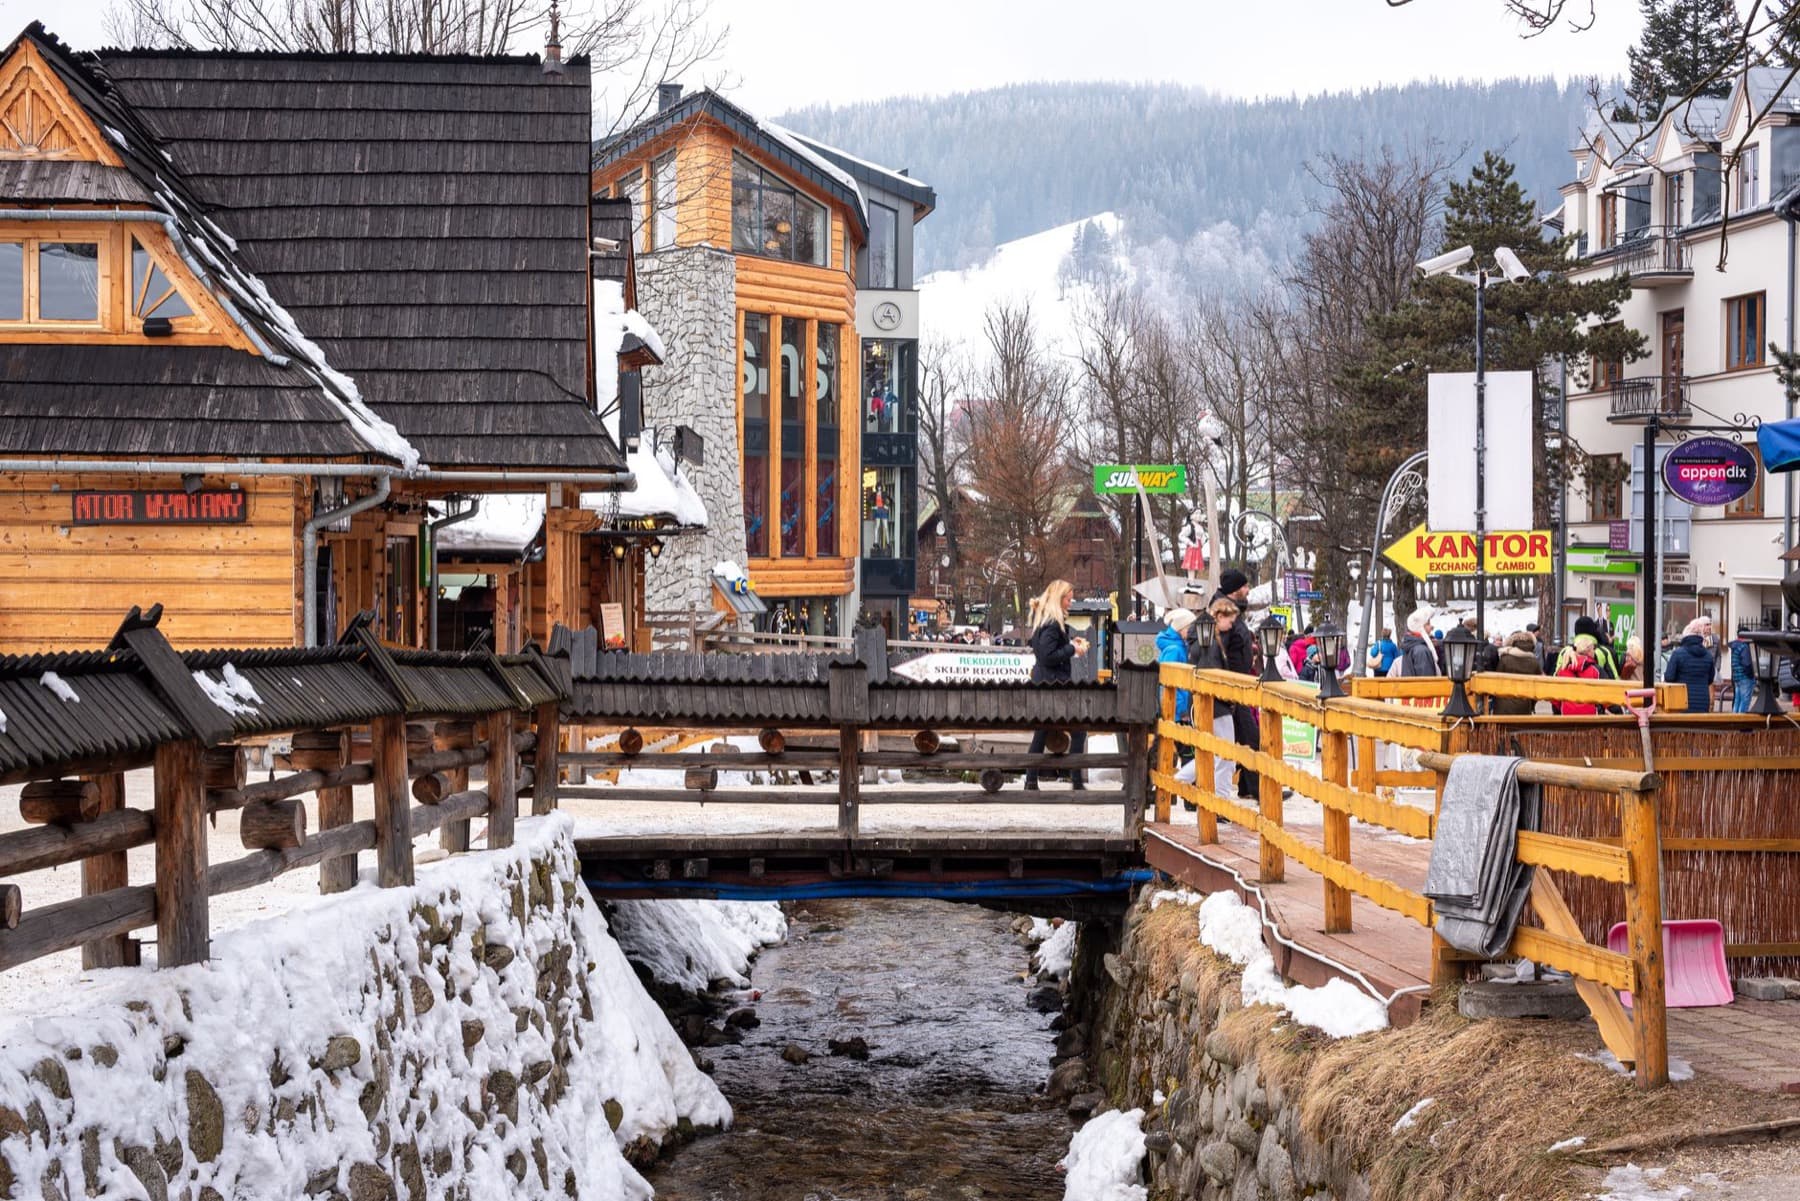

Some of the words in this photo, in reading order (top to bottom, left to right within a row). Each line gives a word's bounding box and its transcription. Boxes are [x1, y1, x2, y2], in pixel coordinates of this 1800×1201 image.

[1104, 471, 1177, 488] SUBWAY
[1681, 465, 1747, 480] appendix
[1416, 534, 1549, 559] KANTOR
[1429, 562, 1477, 572] EXCHANG
[1496, 561, 1536, 570] CAMBIO
[935, 666, 970, 674] SKLEP
